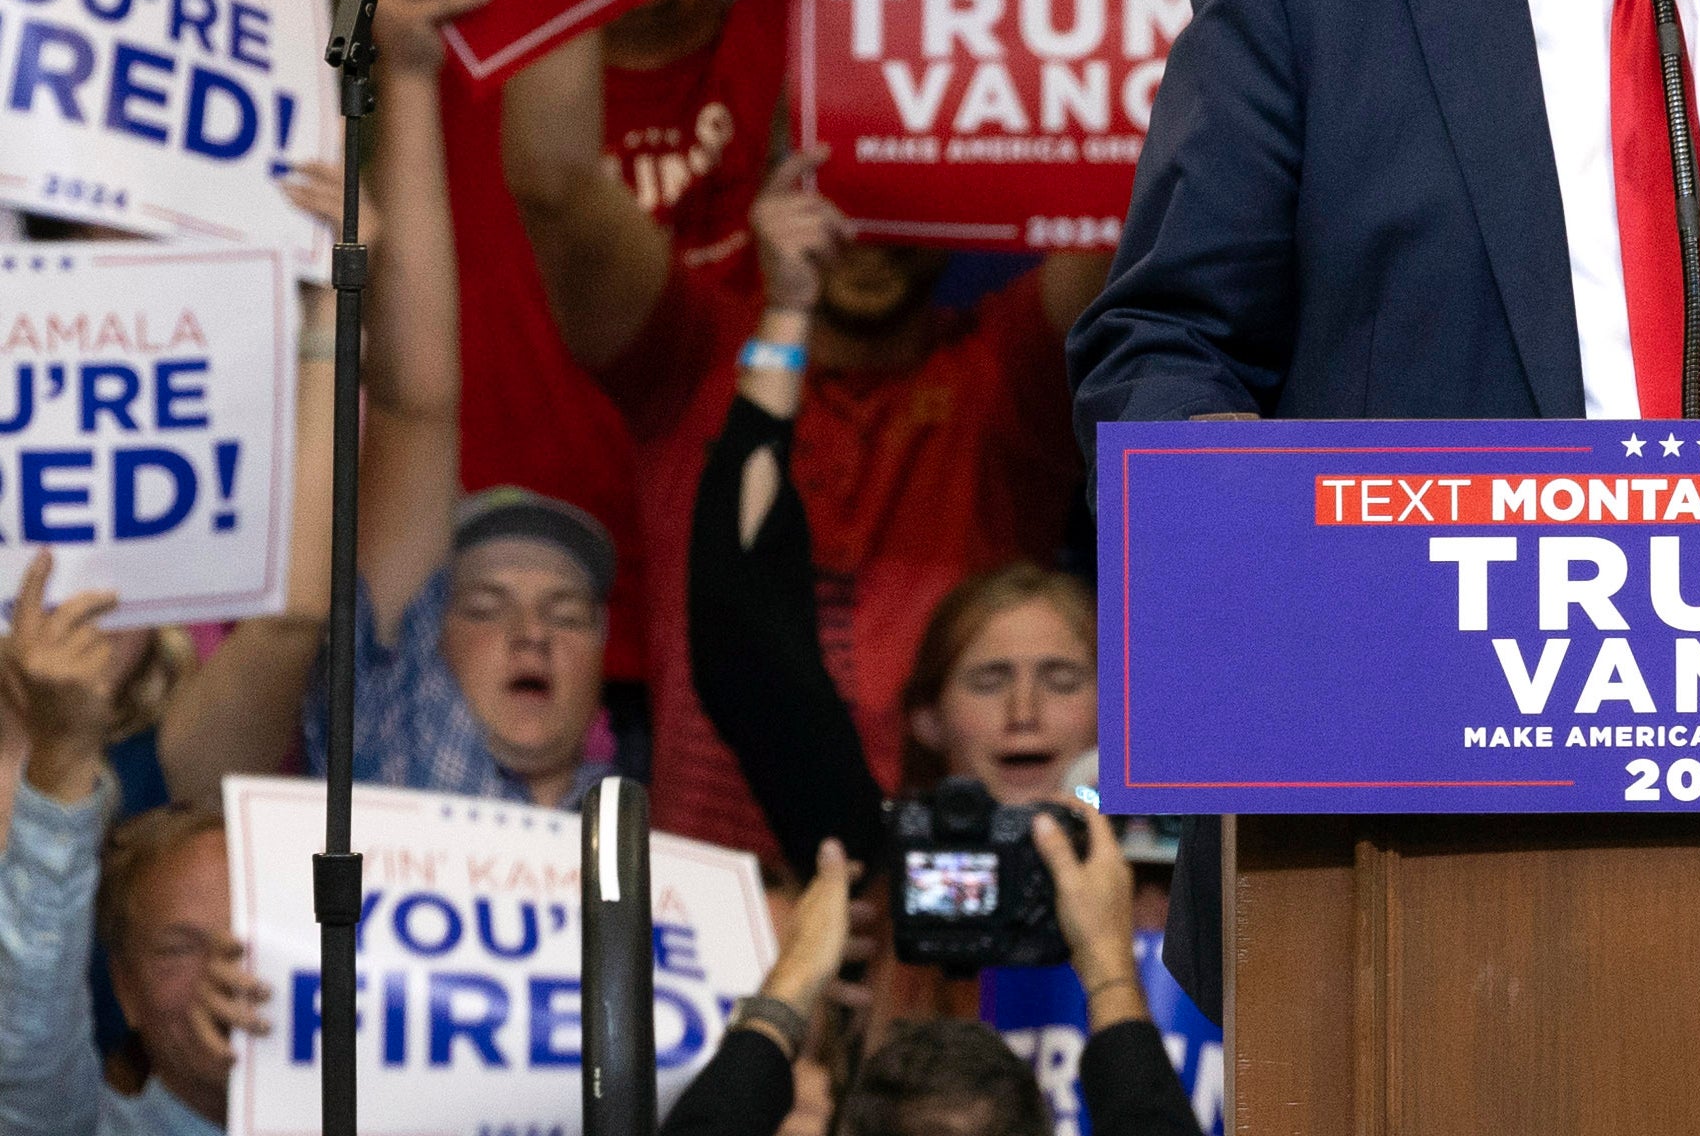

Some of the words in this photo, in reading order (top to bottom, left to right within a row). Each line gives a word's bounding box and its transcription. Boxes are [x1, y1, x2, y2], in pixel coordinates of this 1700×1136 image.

[6, 14, 296, 179] RED!
[882, 60, 1166, 134] VANC
[0, 307, 209, 353] AMALA
[12, 438, 242, 546] ED!
[1322, 476, 1472, 521] TEXT
[1464, 724, 1553, 748] MAKE
[365, 847, 448, 891] YIN'
[289, 967, 738, 1071] FIRED
